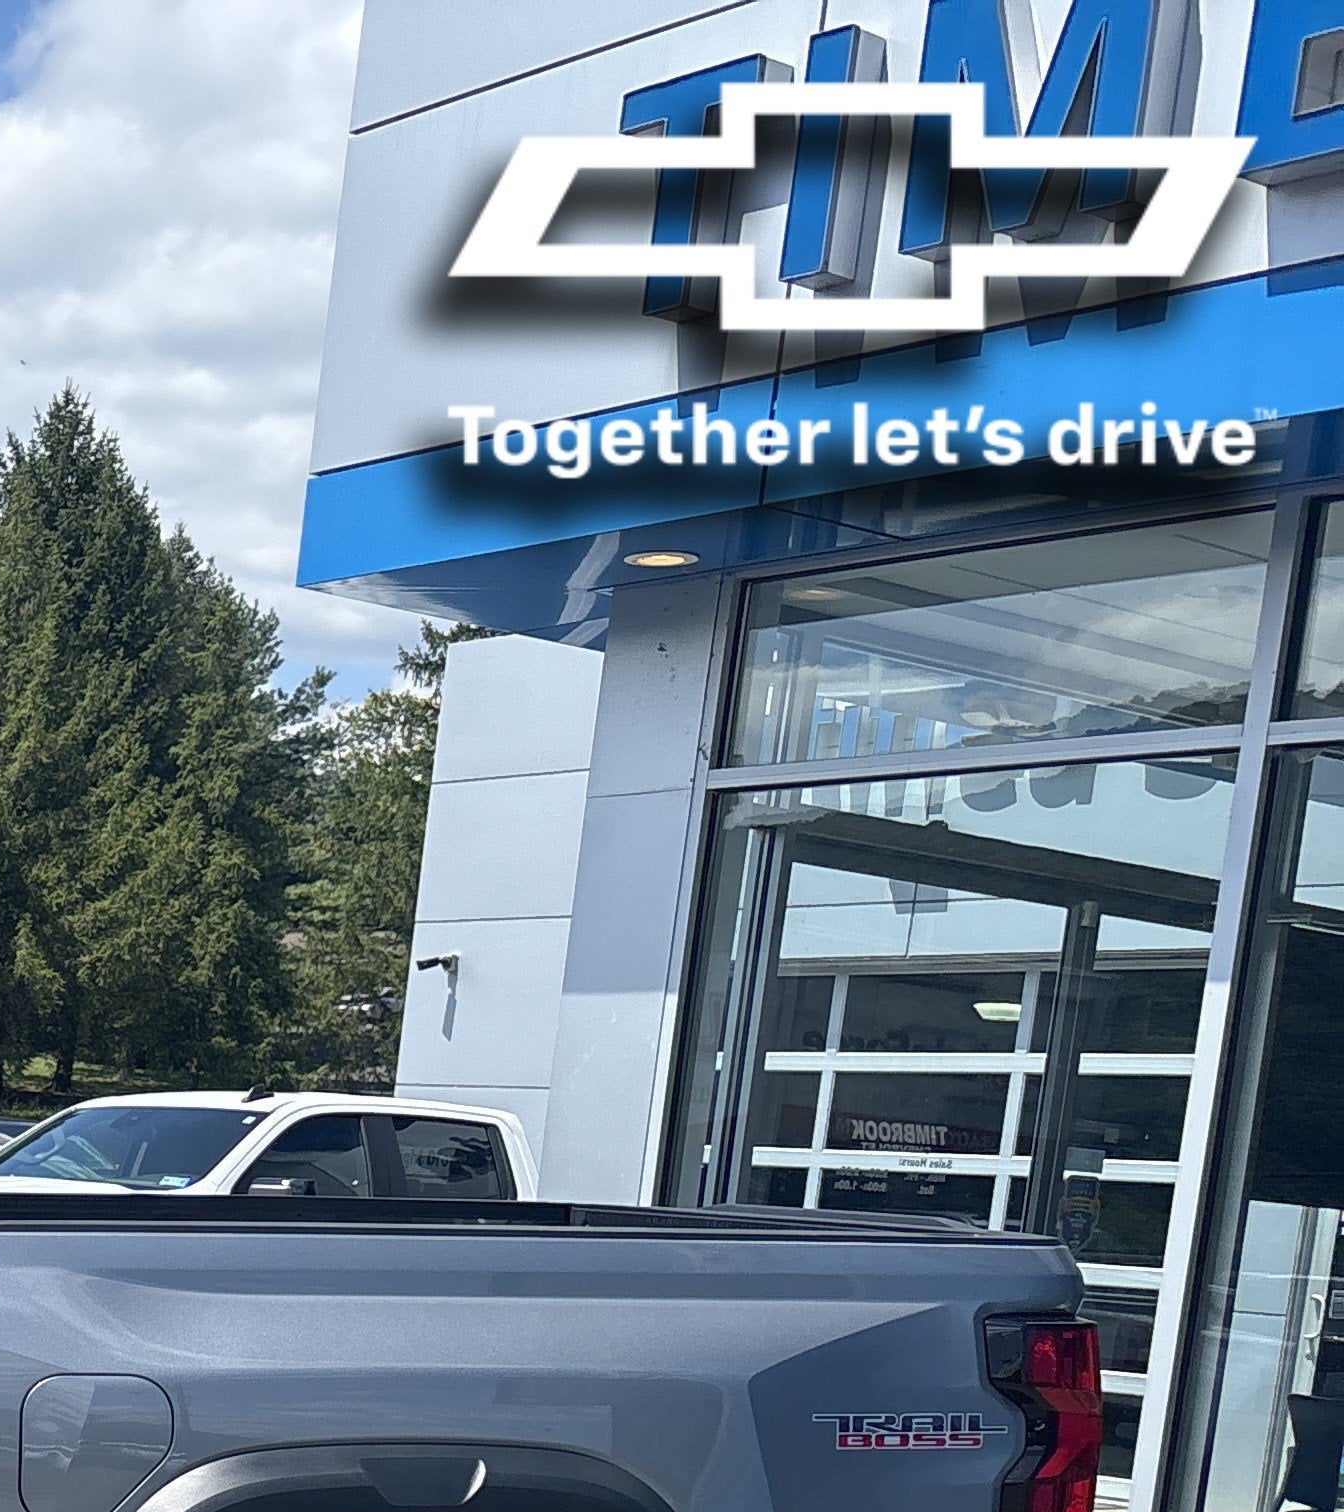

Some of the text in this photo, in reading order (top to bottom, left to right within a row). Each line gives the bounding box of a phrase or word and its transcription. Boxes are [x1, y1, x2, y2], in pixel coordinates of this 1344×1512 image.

[620, 0, 1344, 320] TIM
[812, 1412, 1009, 1435] TRAIL
[836, 1433, 984, 1451] BOSS
